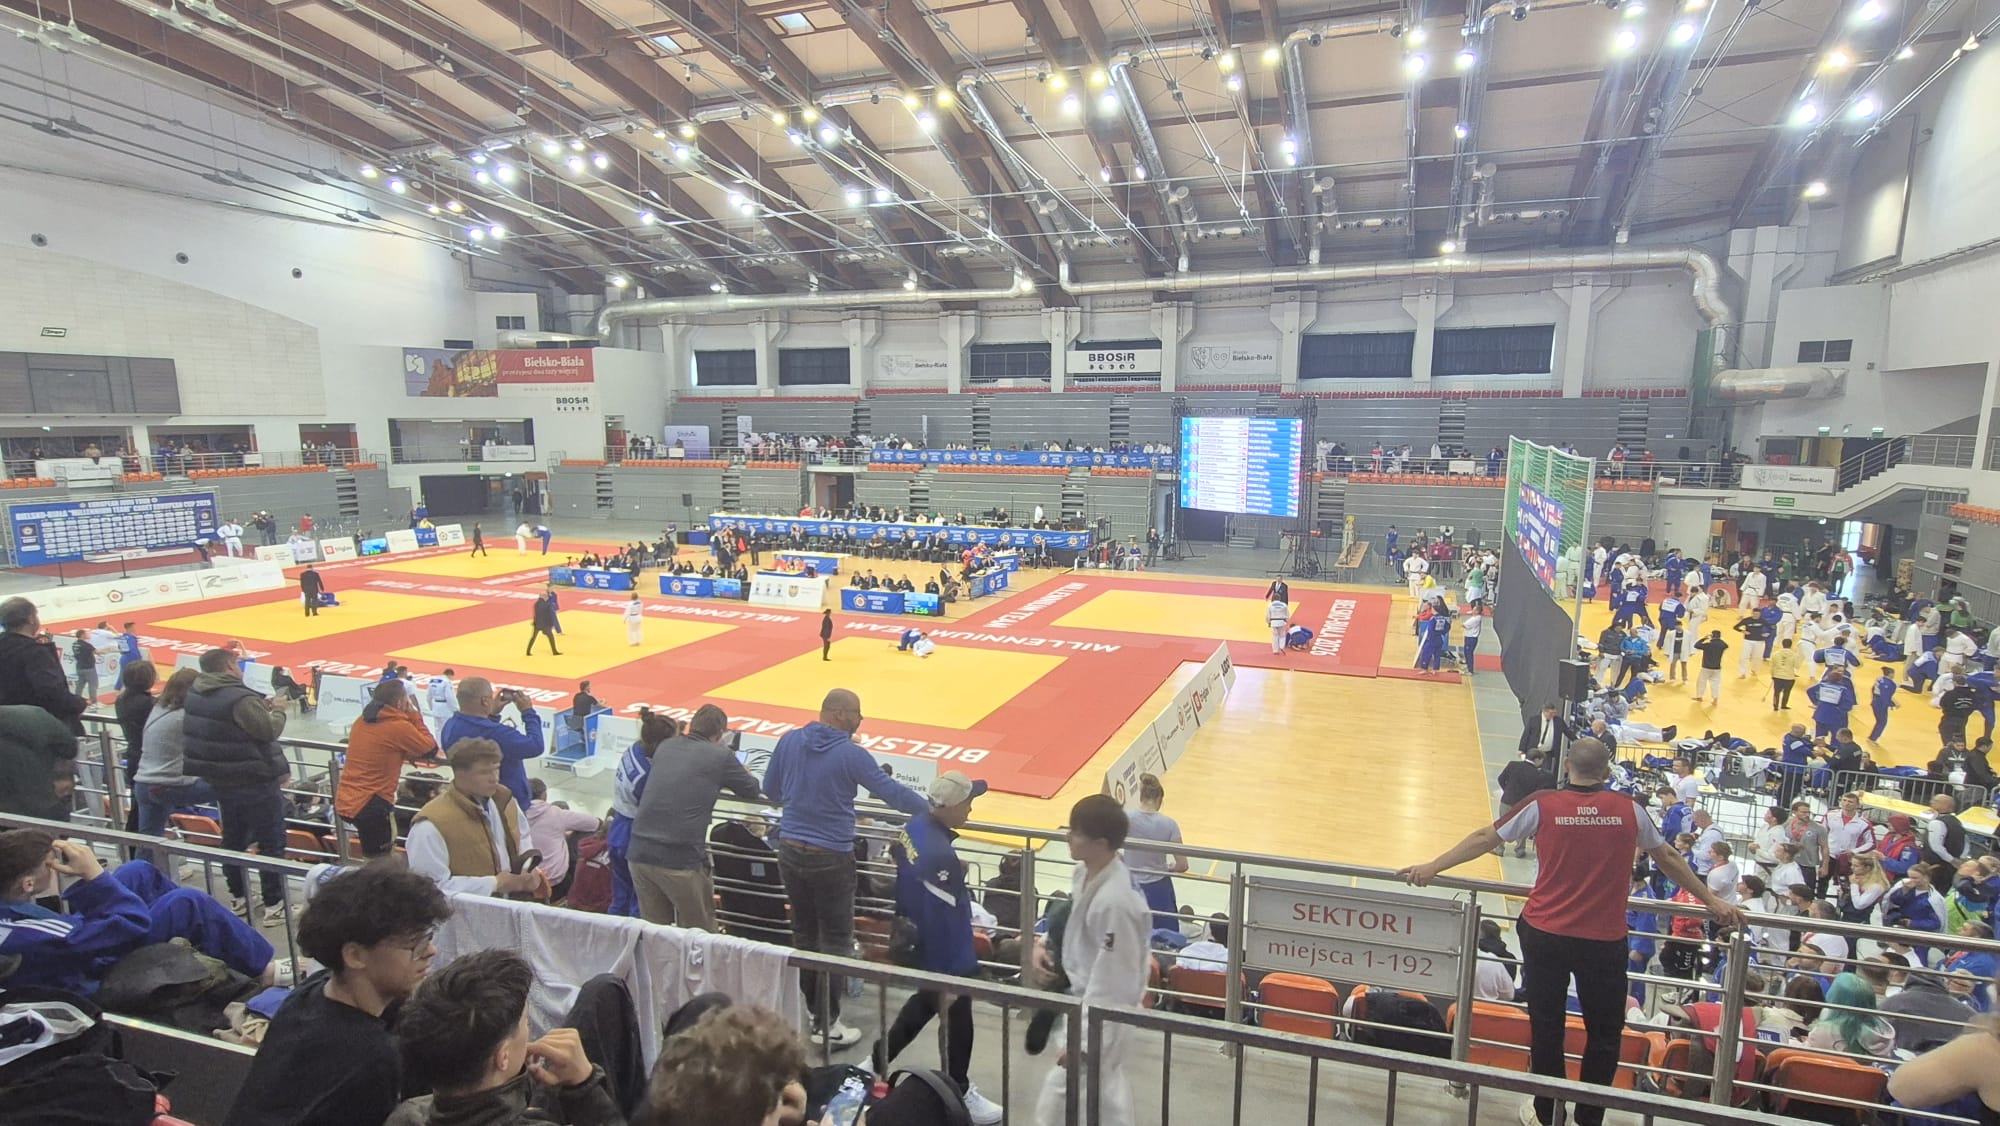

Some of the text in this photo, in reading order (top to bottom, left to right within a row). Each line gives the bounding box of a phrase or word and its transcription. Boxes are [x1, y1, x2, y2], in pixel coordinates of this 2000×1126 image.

[524, 355, 585, 368] Bielsko-Biała
[1088, 353, 1136, 362] BBOSiR
[929, 629, 1122, 653] MILLENNIUM
[896, 772, 919, 783] Polski
[1576, 806, 1599, 815] JUDO
[1555, 816, 1623, 826] NIEDERSACHSEN
[1292, 902, 1413, 935] SEKTOR I
[1268, 940, 1434, 977] miejsca 1-192
